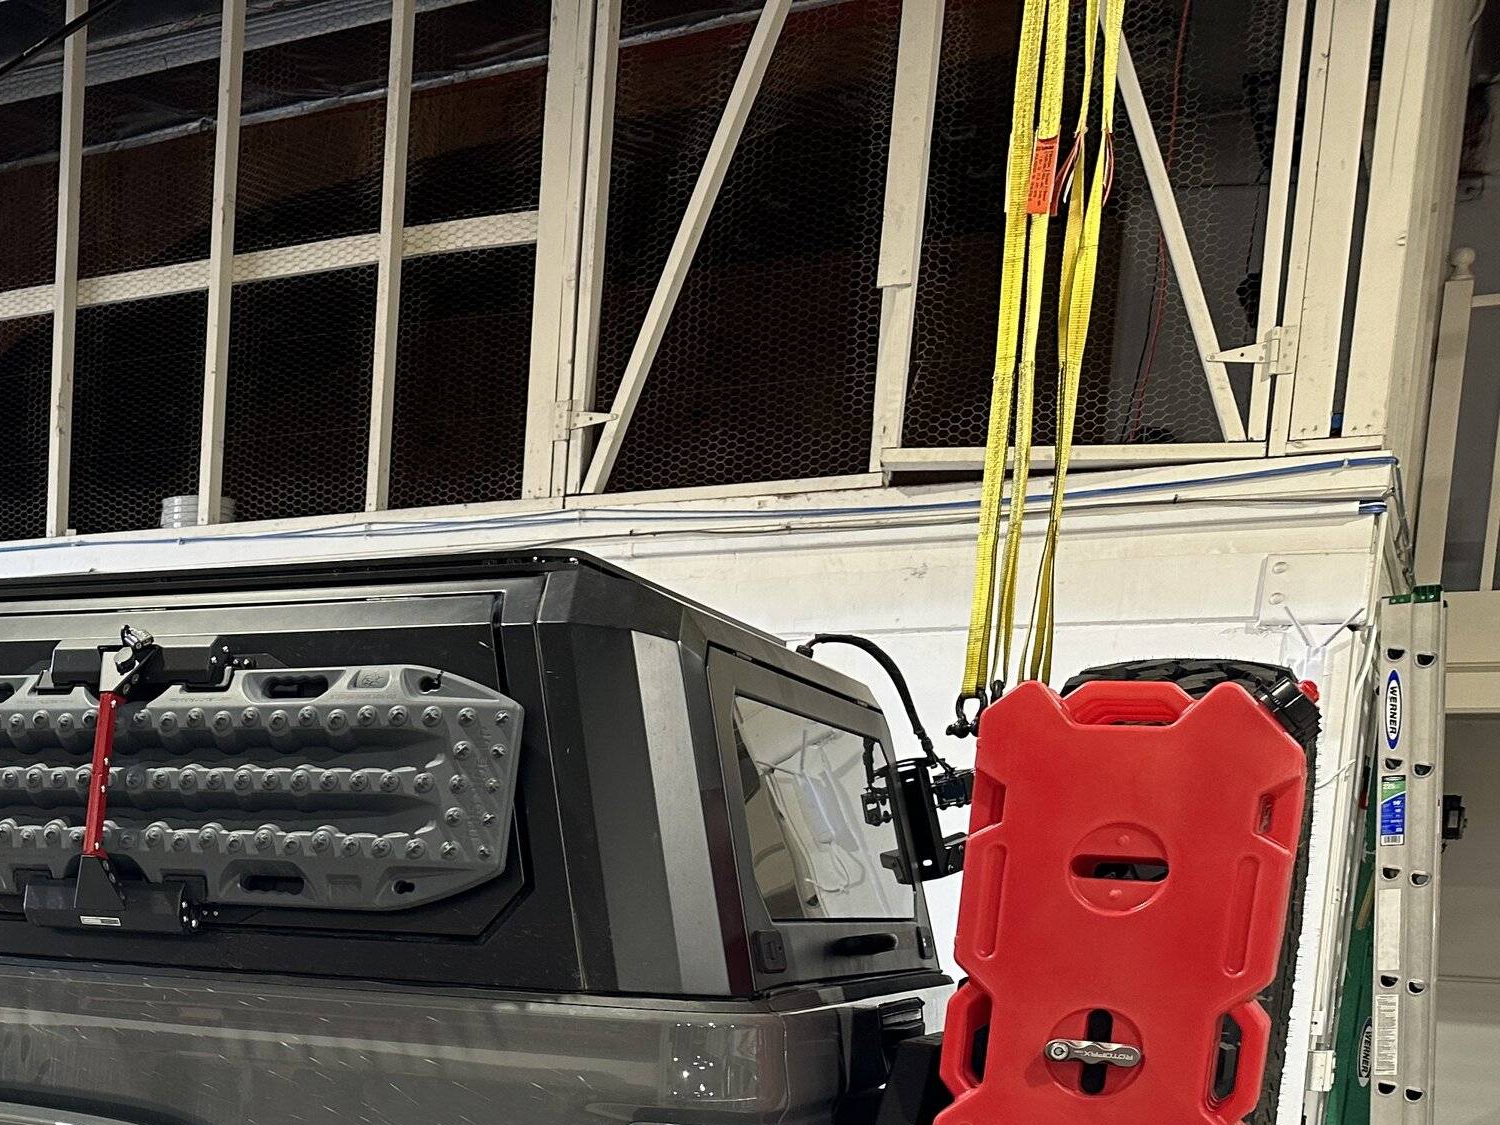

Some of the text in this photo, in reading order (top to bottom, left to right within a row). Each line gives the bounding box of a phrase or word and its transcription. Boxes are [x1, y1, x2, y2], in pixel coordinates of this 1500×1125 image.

[1389, 685, 1398, 735] WERNER
[1083, 1049, 1134, 1061] ROTOPAX
[1361, 1029, 1373, 1074] WERNER
